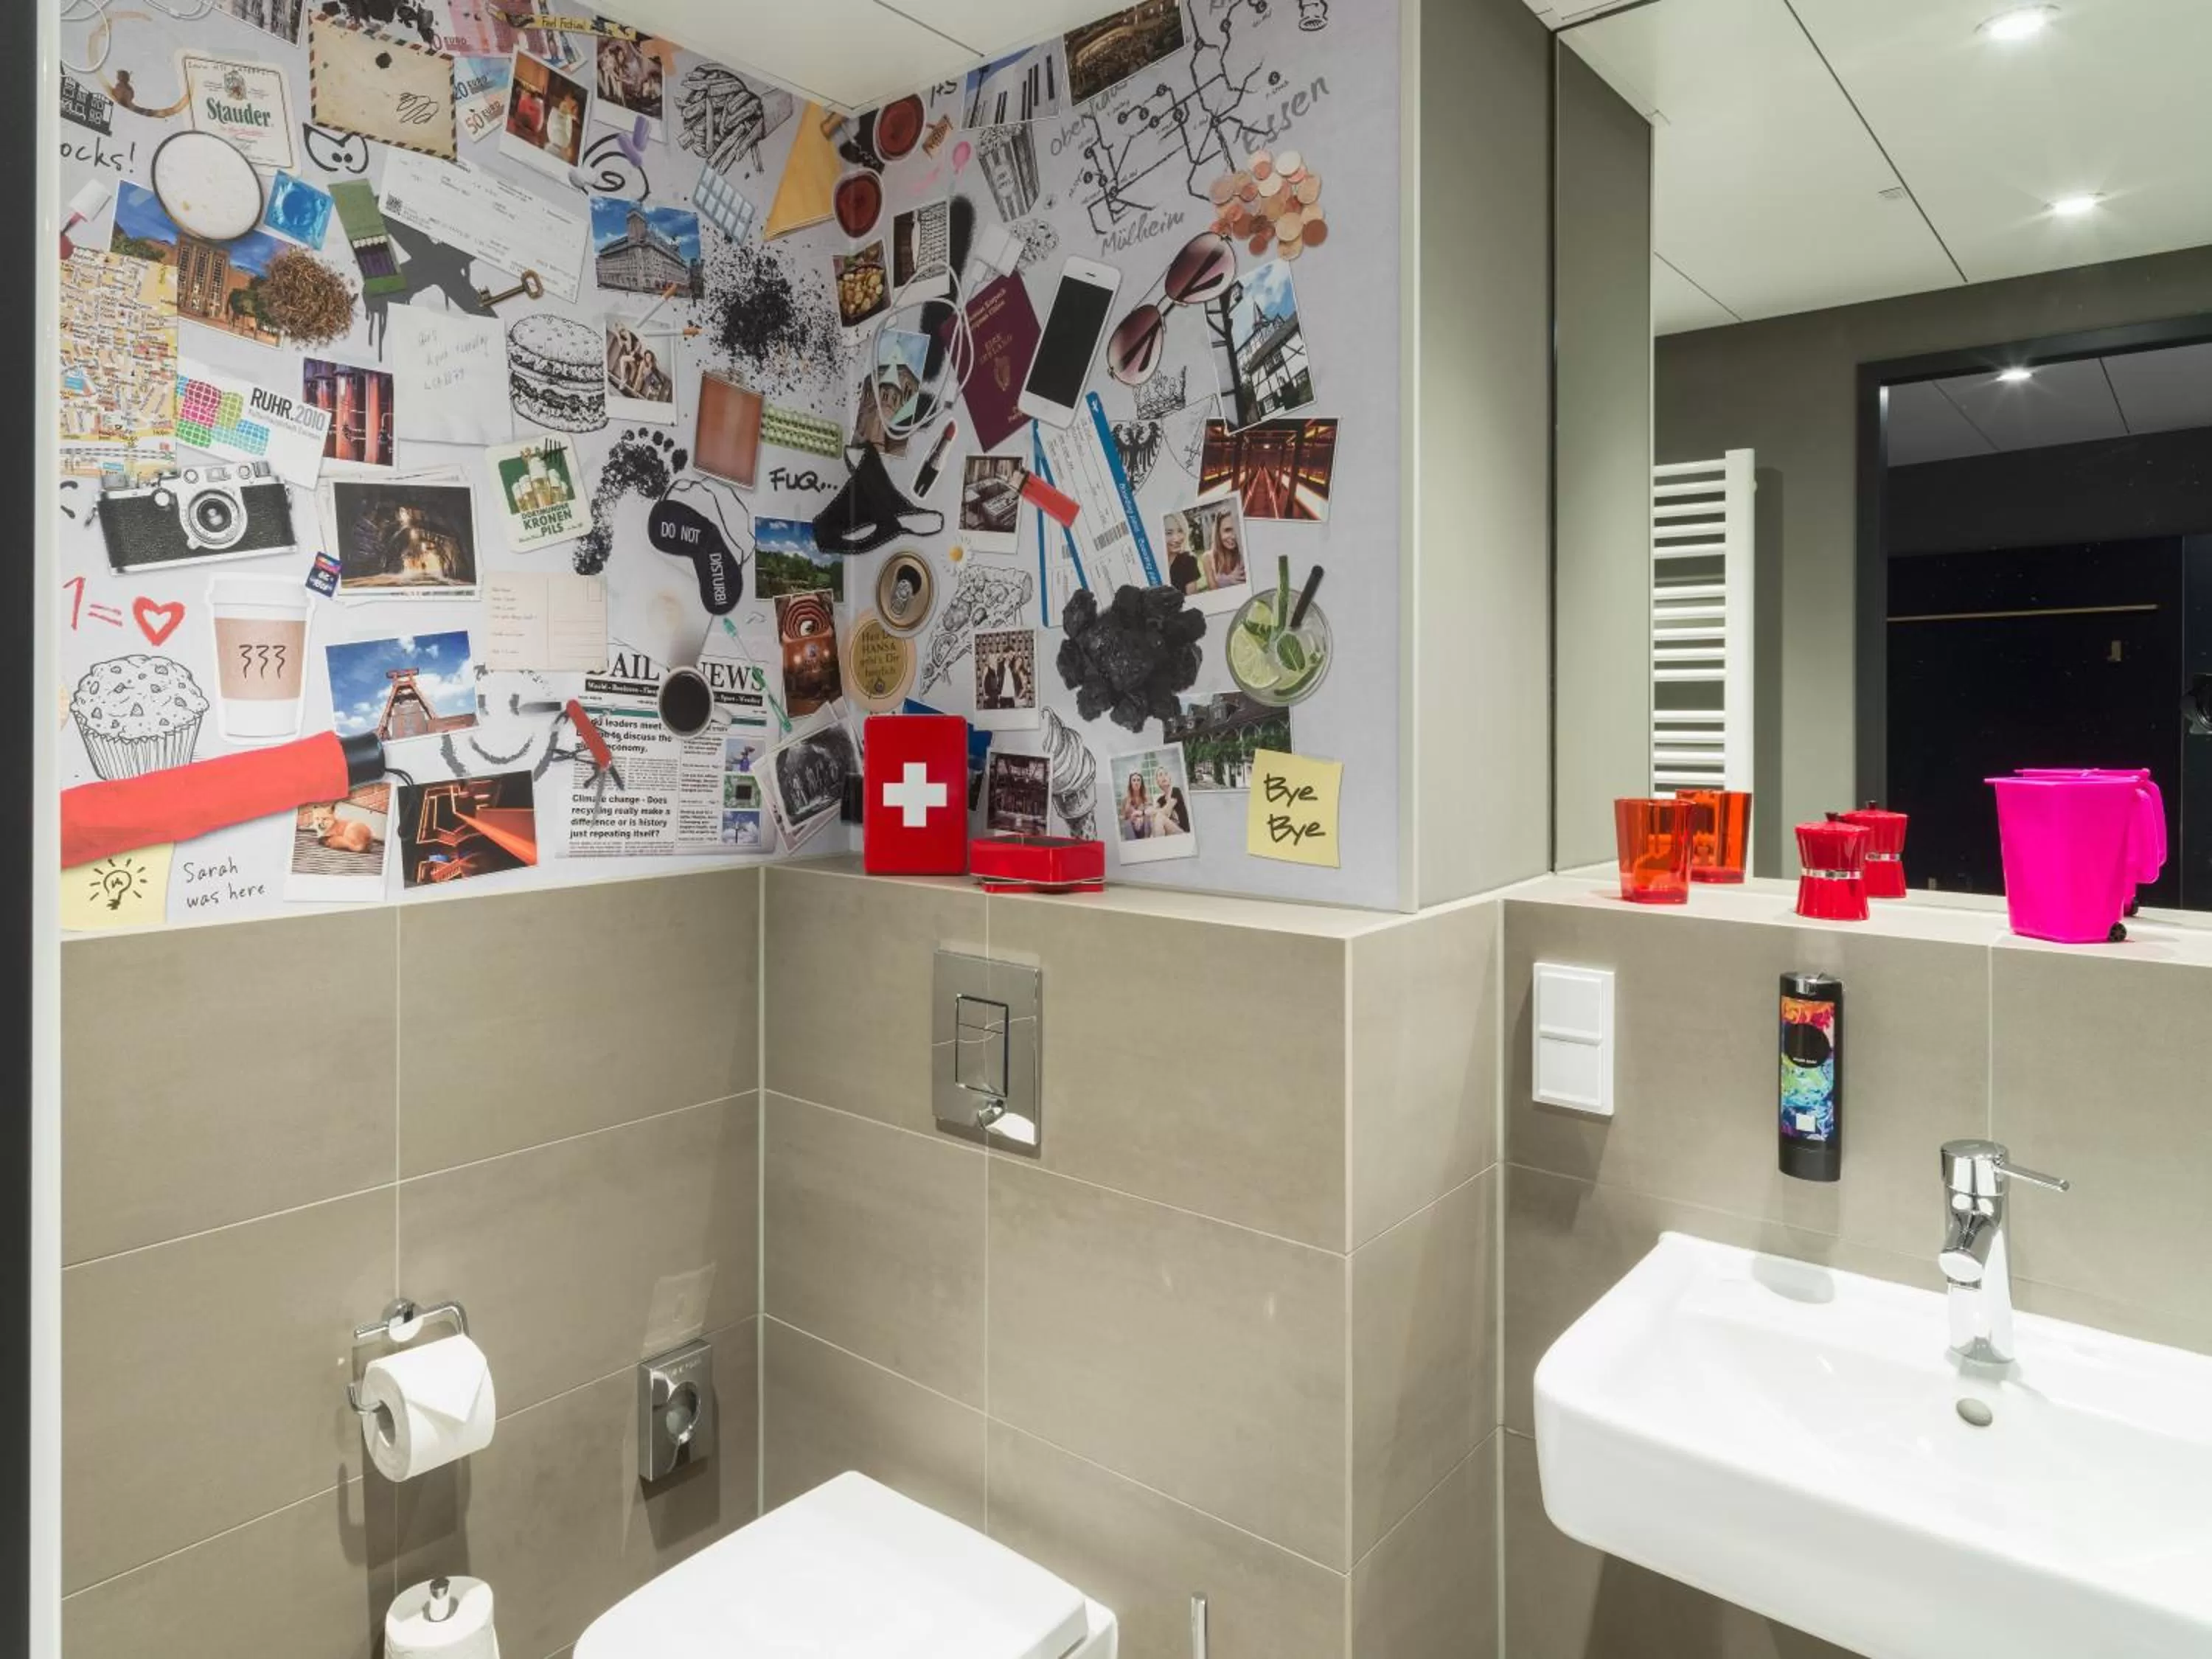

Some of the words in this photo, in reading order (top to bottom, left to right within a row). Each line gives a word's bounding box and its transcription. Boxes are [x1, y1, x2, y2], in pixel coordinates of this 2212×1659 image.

[206, 97, 271, 128] Stauder
[251, 387, 326, 431] RUHR.2010
[523, 509, 573, 530] KRONEN
[540, 523, 564, 537] PILS
[661, 521, 676, 539] DO
[680, 525, 701, 544] NOT
[605, 717, 638, 728] leaders
[640, 721, 663, 730] meet
[623, 731, 657, 741] discuss
[658, 734, 673, 742] the
[608, 795, 640, 805] change
[647, 796, 667, 804] Does
[1263, 772, 1319, 808] Bye
[614, 807, 639, 816] really
[641, 807, 664, 815] make
[629, 818, 636, 826] is
[639, 818, 667, 828] history
[1266, 813, 1326, 846] Bye
[569, 830, 588, 839] just
[589, 830, 631, 839] repeating
[183, 855, 238, 883] Sarah
[187, 891, 220, 908] was
[228, 882, 265, 900] here
